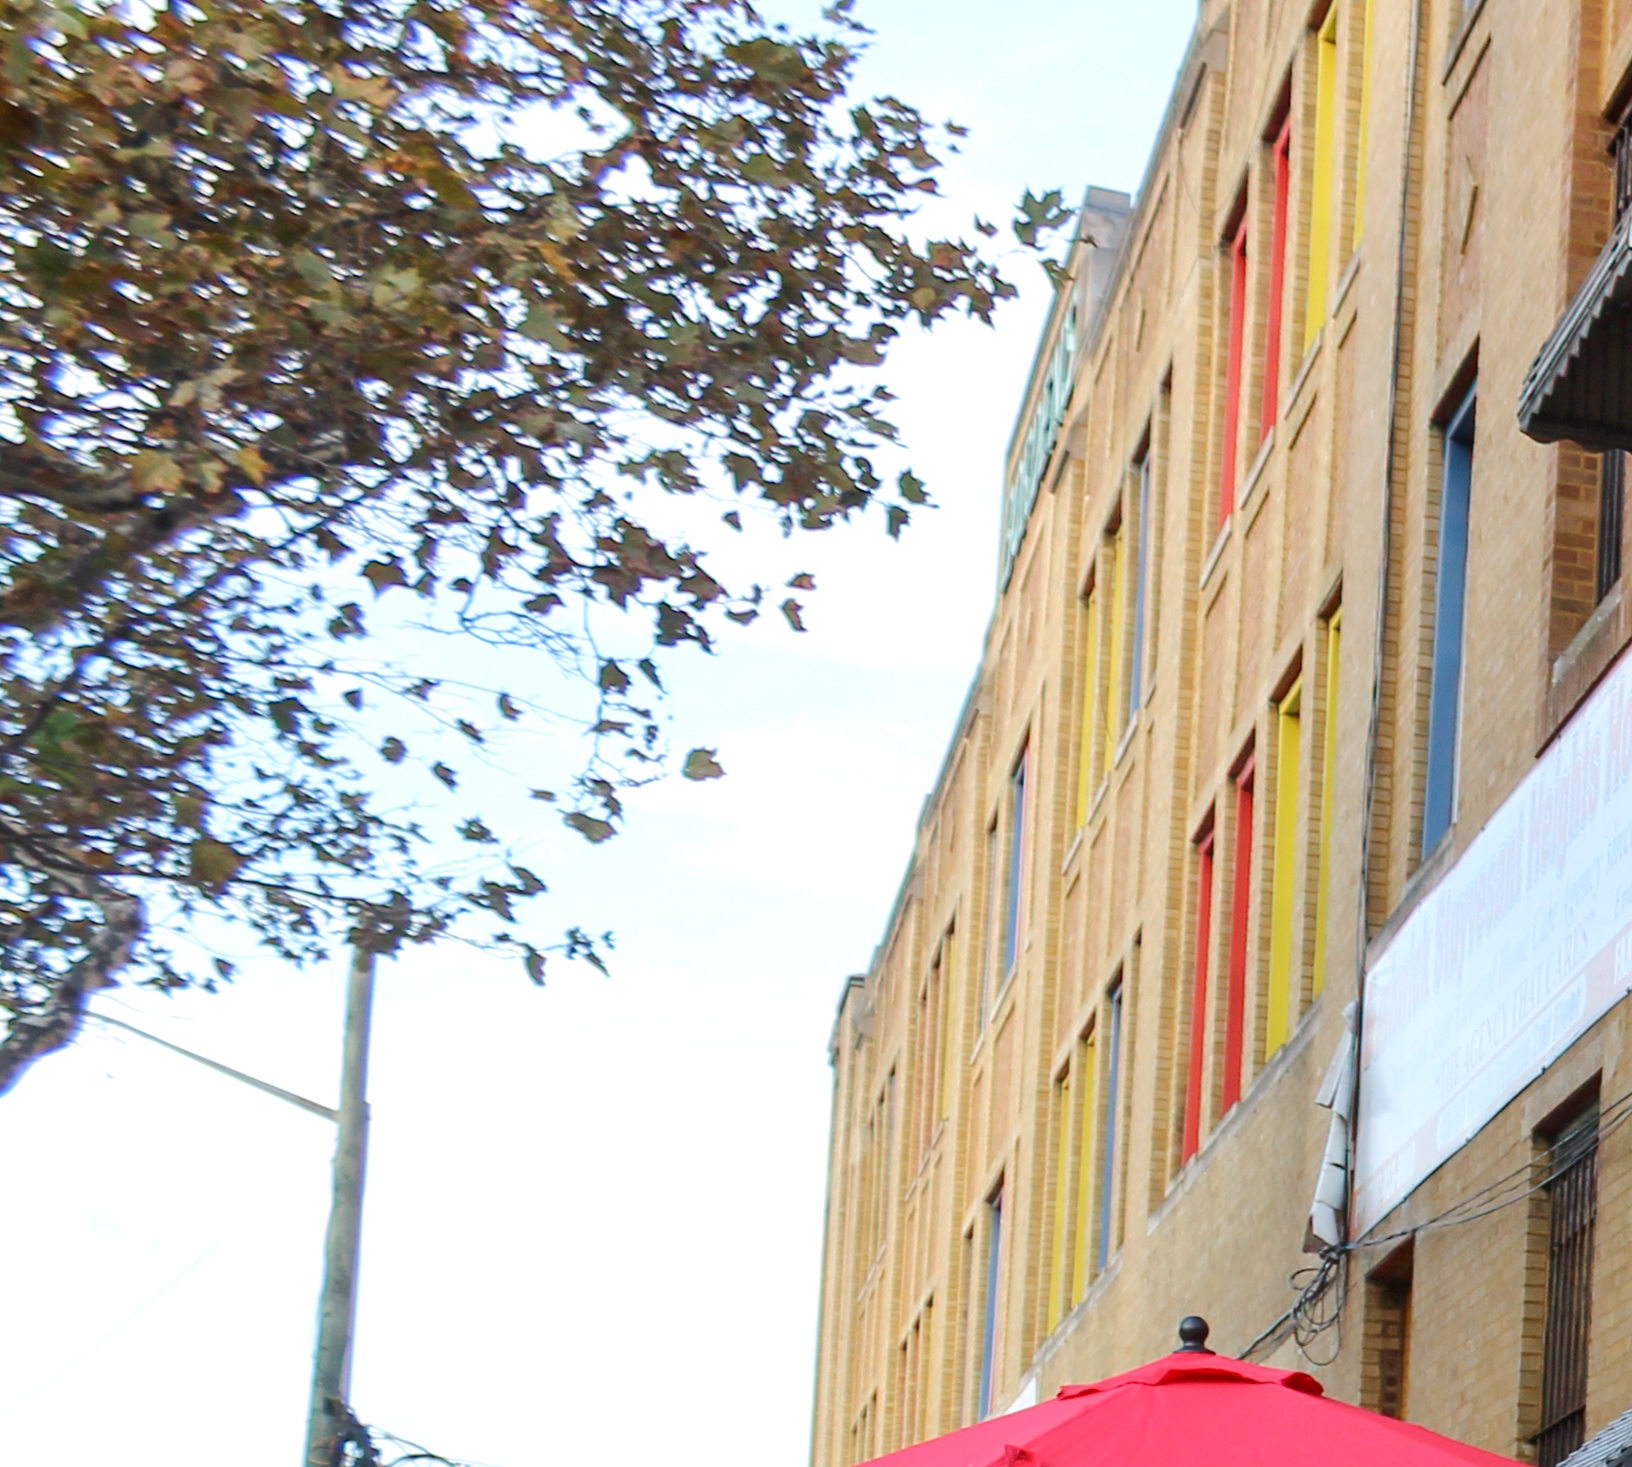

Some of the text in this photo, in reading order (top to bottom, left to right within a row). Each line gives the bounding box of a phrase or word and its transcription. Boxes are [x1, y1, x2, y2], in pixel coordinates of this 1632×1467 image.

[1526, 722, 1602, 890] Heights
[1464, 1002, 1508, 1073] AGENCY
[1512, 964, 1544, 1028] THAT
